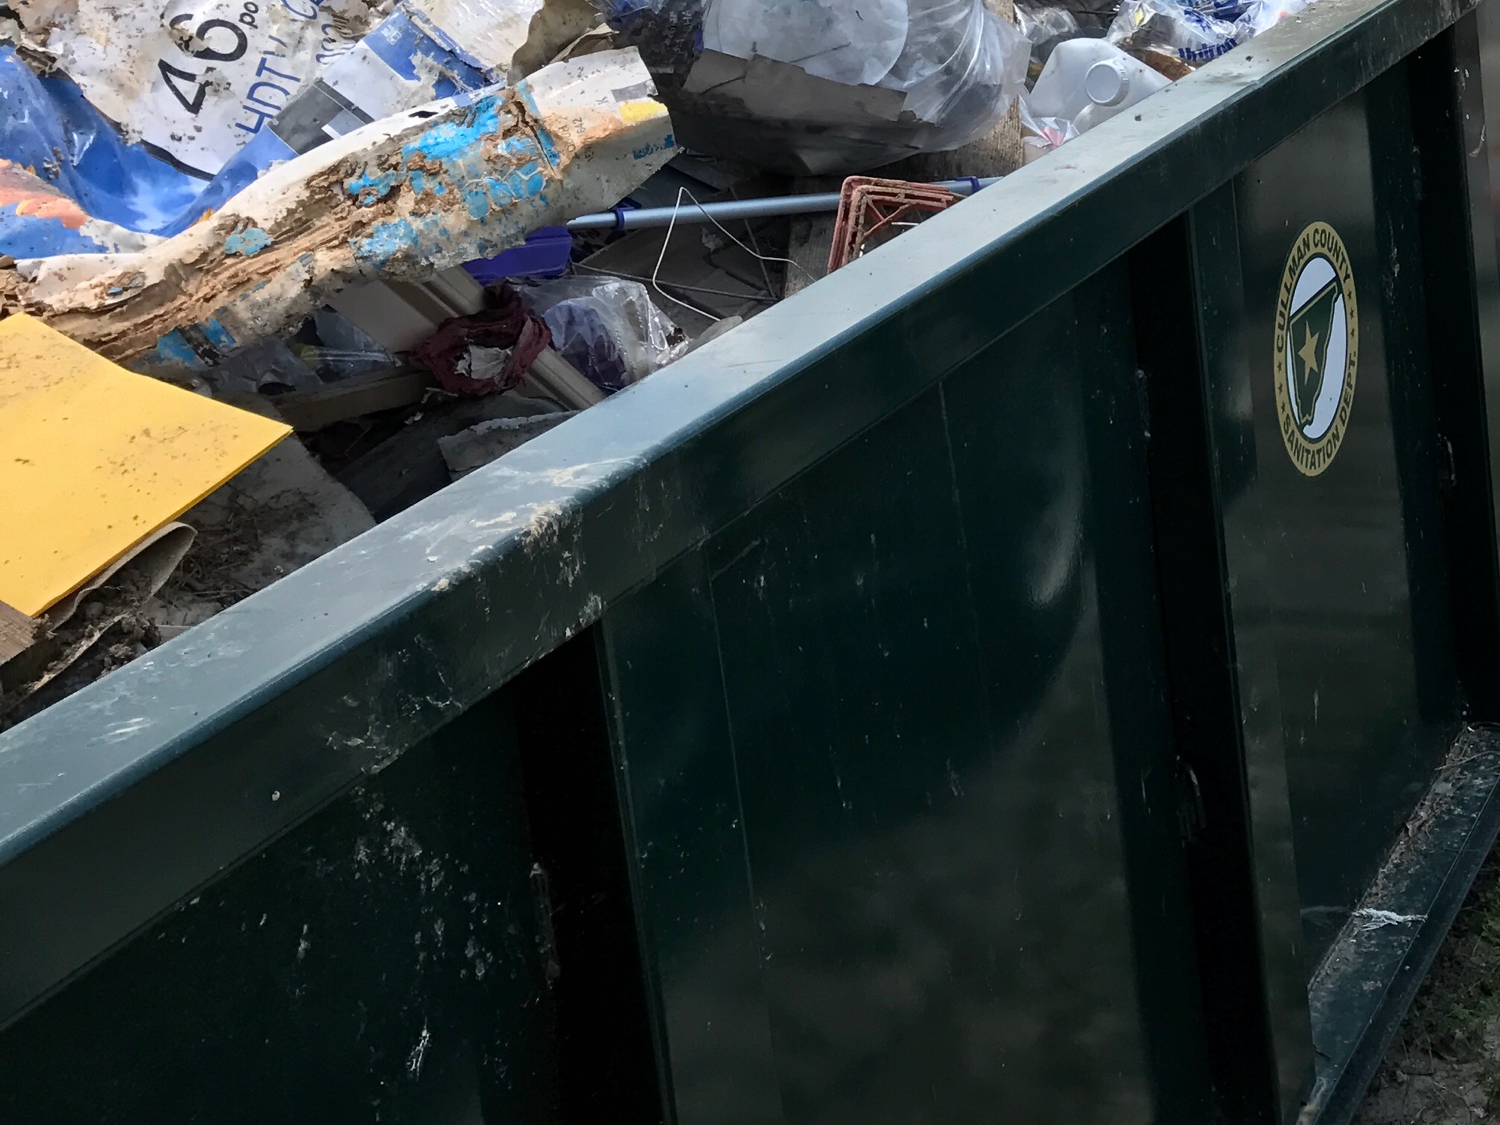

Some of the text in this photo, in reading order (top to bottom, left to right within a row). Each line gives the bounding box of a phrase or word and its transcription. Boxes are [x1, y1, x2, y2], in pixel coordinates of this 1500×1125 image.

[158, 1, 260, 115] 46 po
[1277, 228, 1351, 353] CULLMAN COUNTY
[1283, 350, 1358, 471] SANITATION DEPT.
